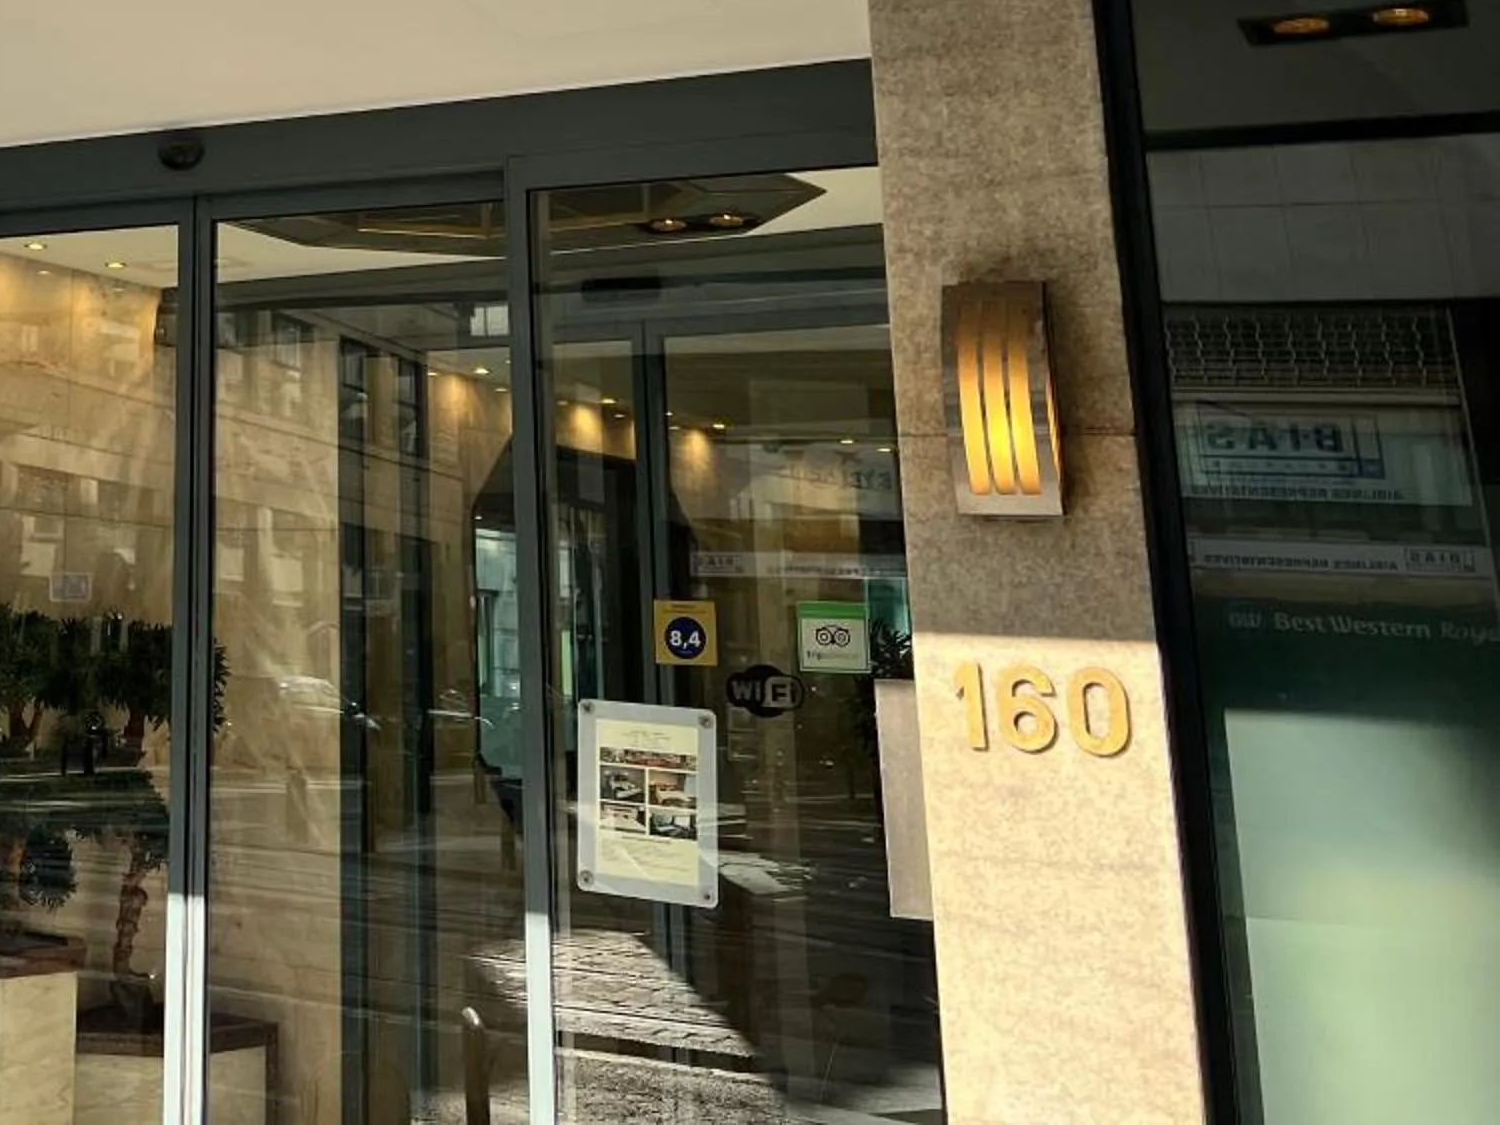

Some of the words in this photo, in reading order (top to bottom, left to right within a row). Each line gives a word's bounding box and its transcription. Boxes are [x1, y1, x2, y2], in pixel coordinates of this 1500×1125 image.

[669, 629, 702, 650] 8,4
[1273, 611, 1327, 633] Best
[1328, 615, 1431, 640] Western
[953, 661, 1133, 758] 160
